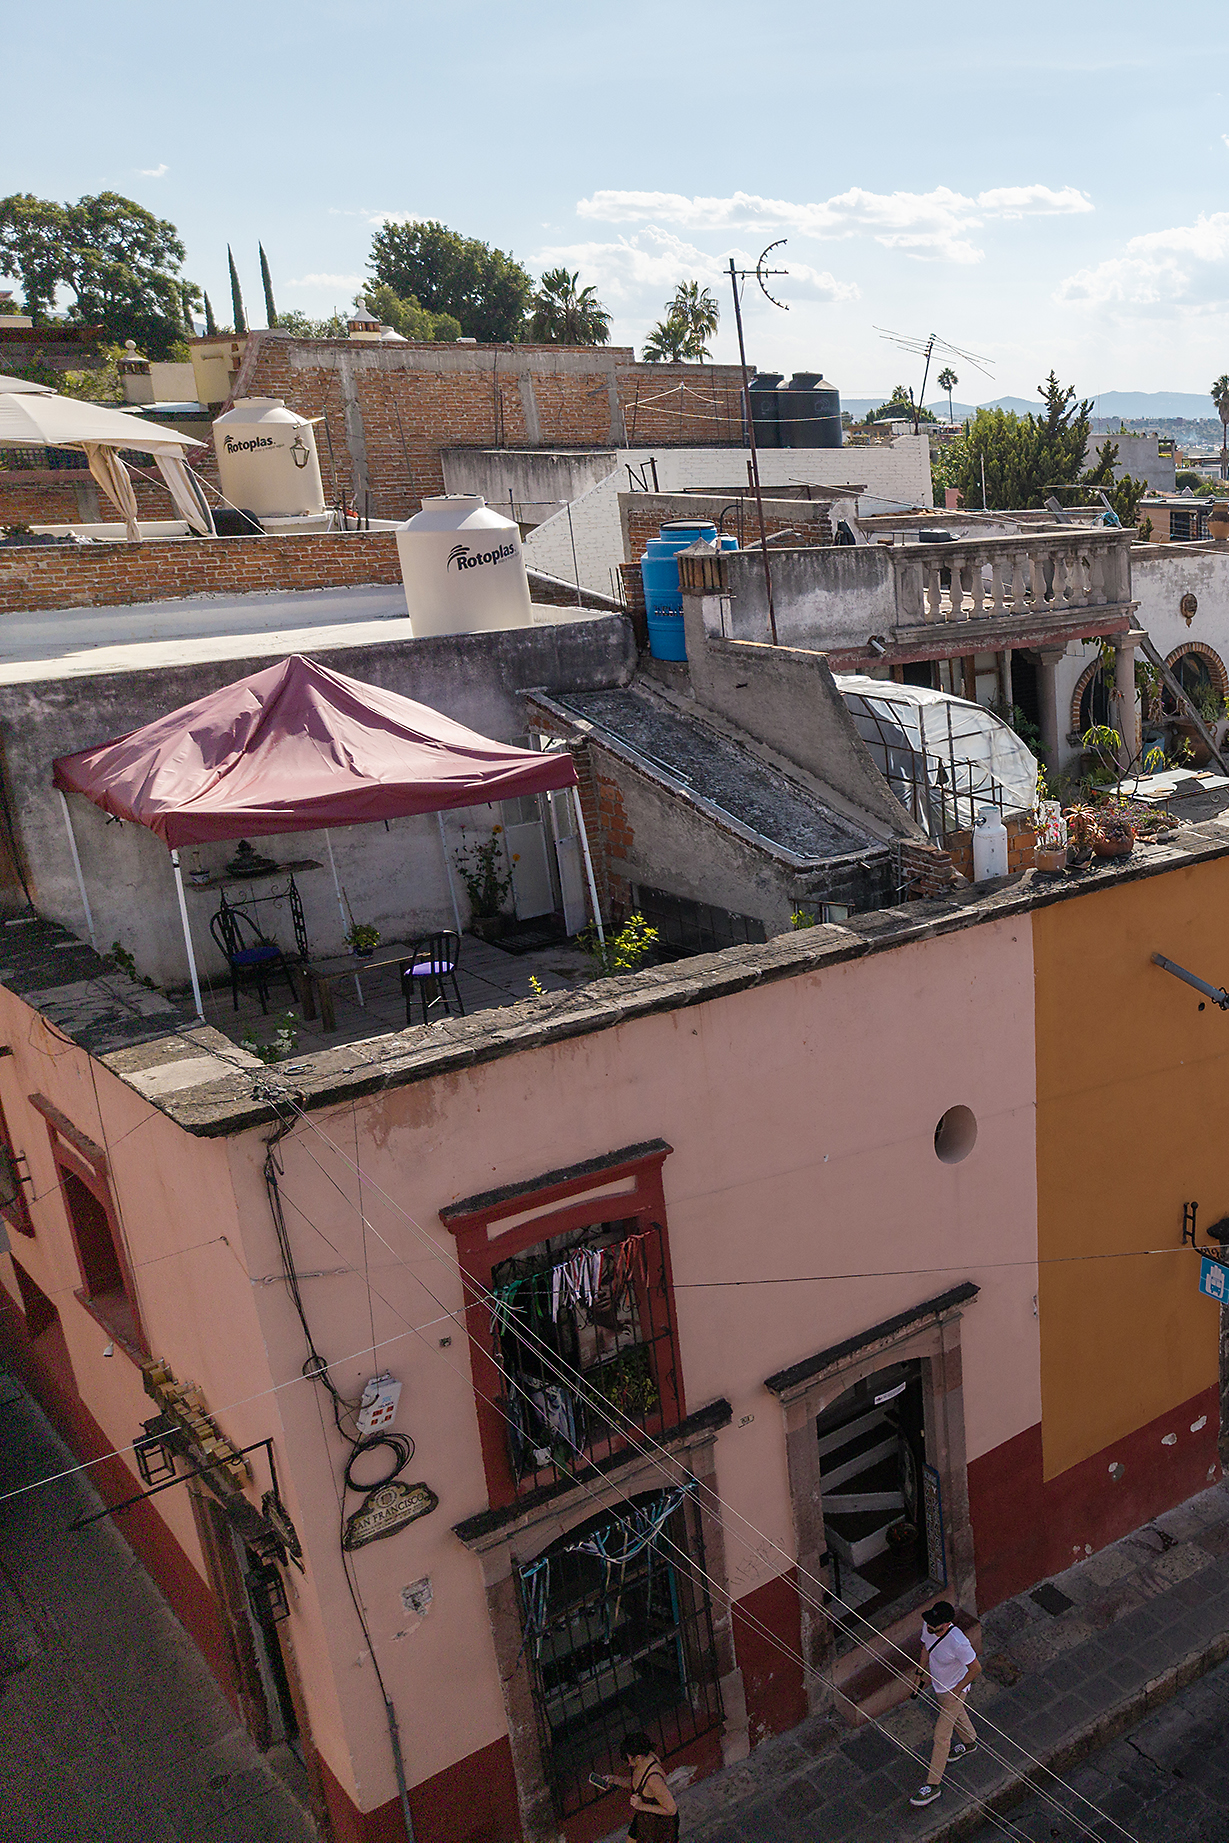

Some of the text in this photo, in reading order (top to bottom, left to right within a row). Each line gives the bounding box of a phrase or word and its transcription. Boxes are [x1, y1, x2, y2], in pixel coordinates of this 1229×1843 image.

[227, 436, 273, 454] Rotoplas
[456, 543, 515, 571] Rotoplas
[351, 1515, 371, 1533] SAN
[372, 1492, 424, 1524] FRANCISCO
